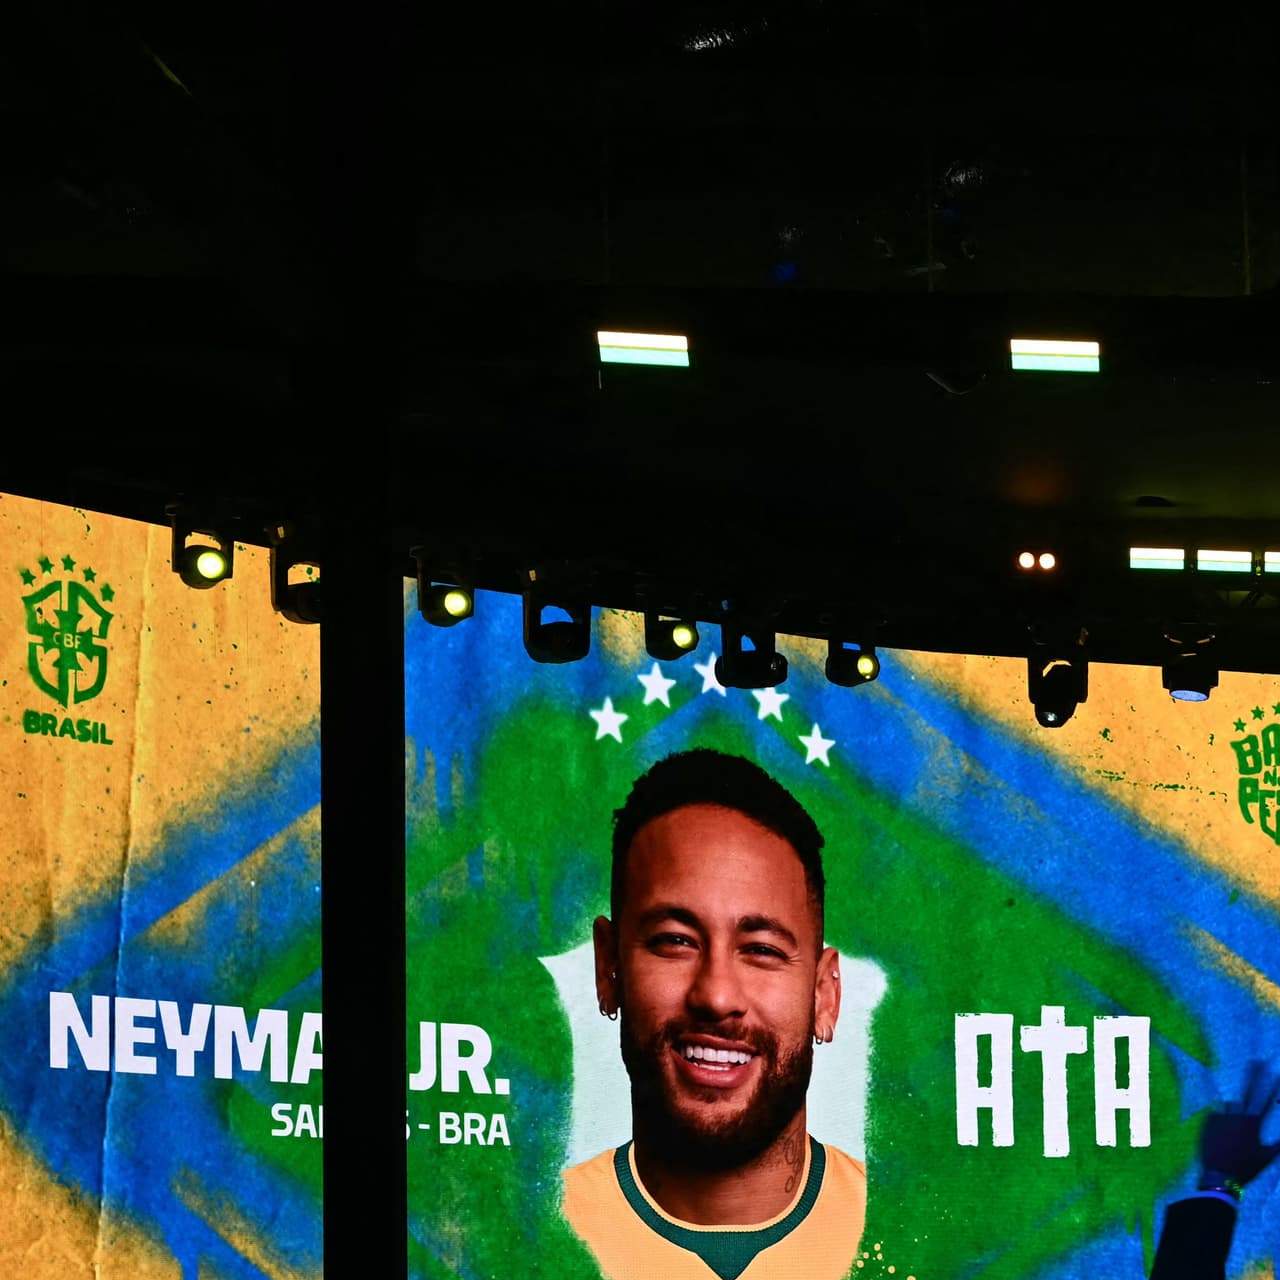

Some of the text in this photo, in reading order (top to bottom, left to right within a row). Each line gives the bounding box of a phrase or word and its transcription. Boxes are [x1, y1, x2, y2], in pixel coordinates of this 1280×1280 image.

[23, 709, 113, 745] BRASIL
[49, 992, 510, 1095] NEYMA JR.
[954, 1005, 1150, 1158] ATA
[439, 1111, 511, 1146] BRA
